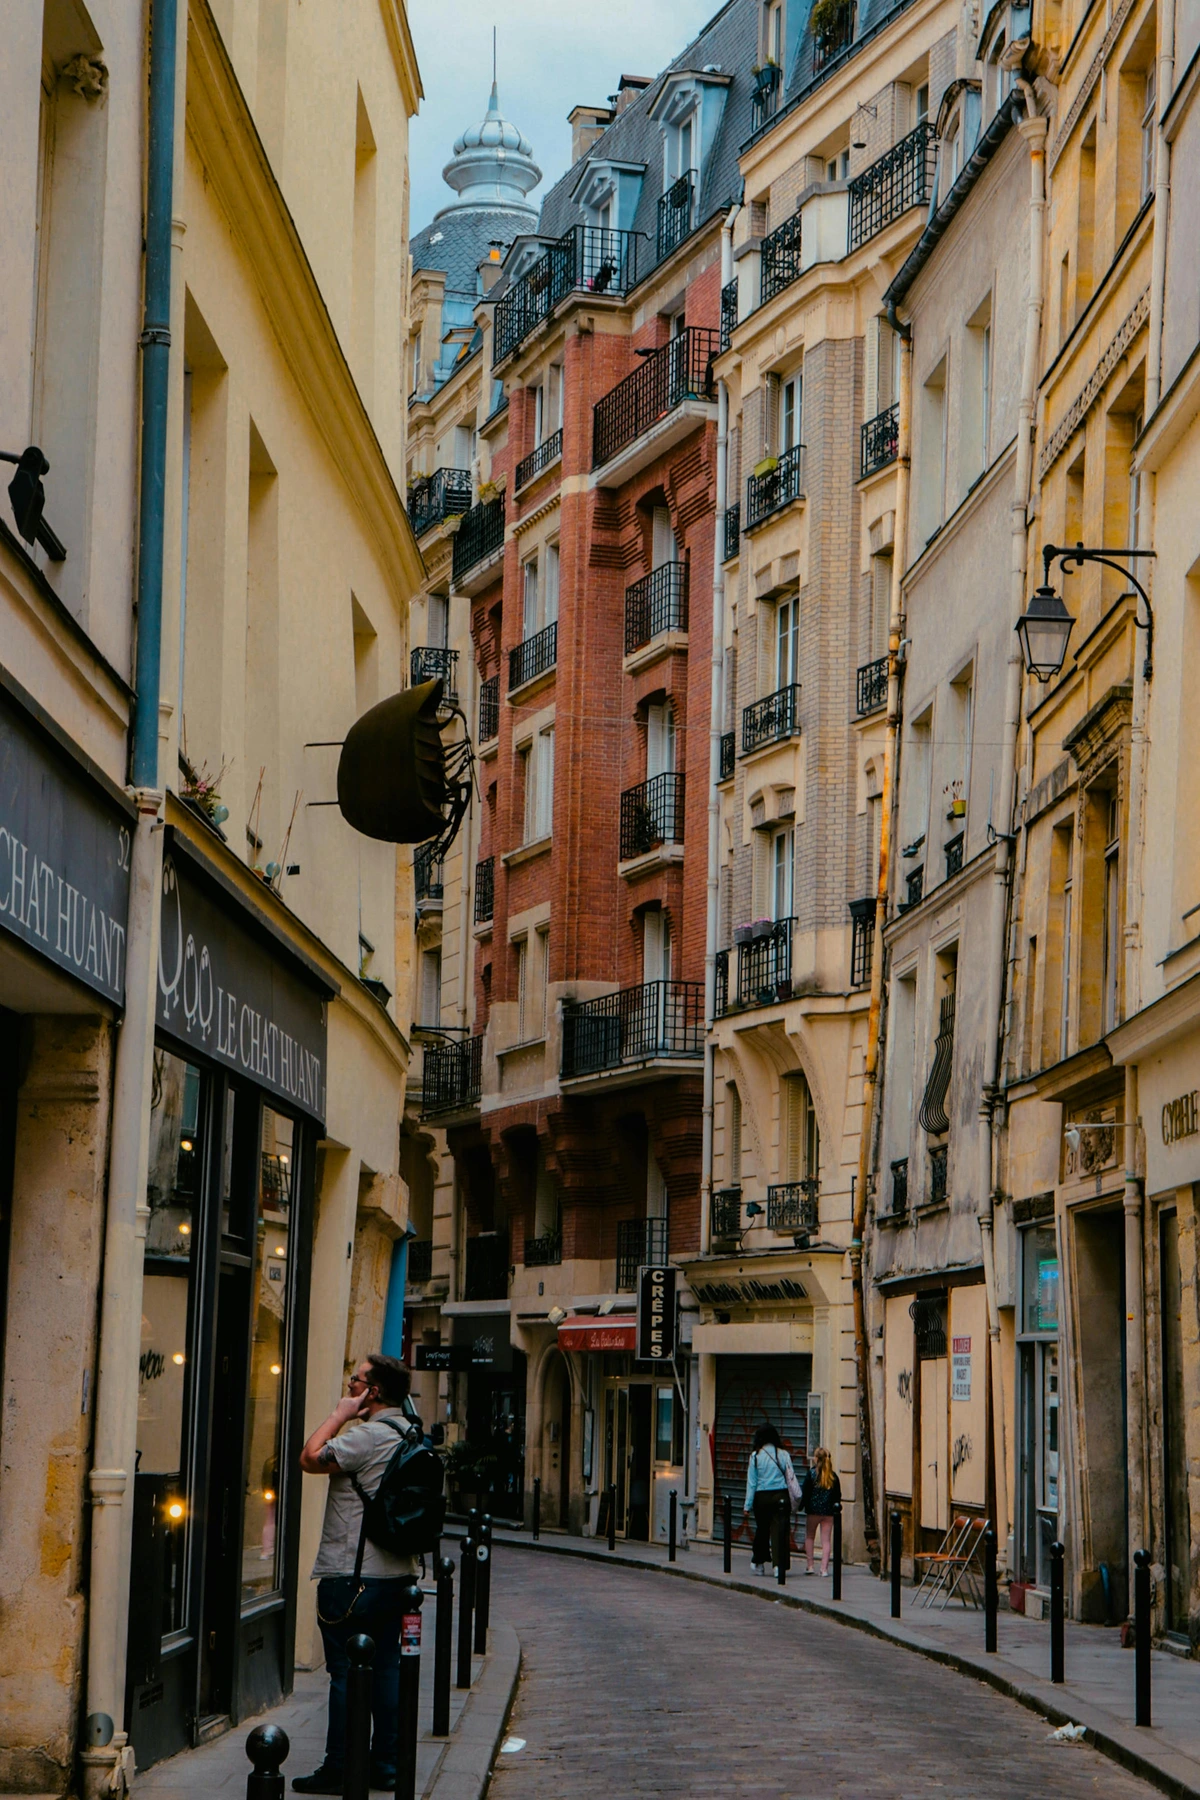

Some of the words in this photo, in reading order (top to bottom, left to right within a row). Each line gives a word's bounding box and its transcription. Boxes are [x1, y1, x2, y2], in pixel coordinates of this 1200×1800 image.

[117, 825, 131, 873] 52
[55, 876, 125, 992] HUANT
[217, 987, 237, 1060] LE
[240, 1003, 279, 1083] CHAT
[280, 1030, 321, 1112] HUANT
[650, 1270, 665, 1358] CRÊPES
